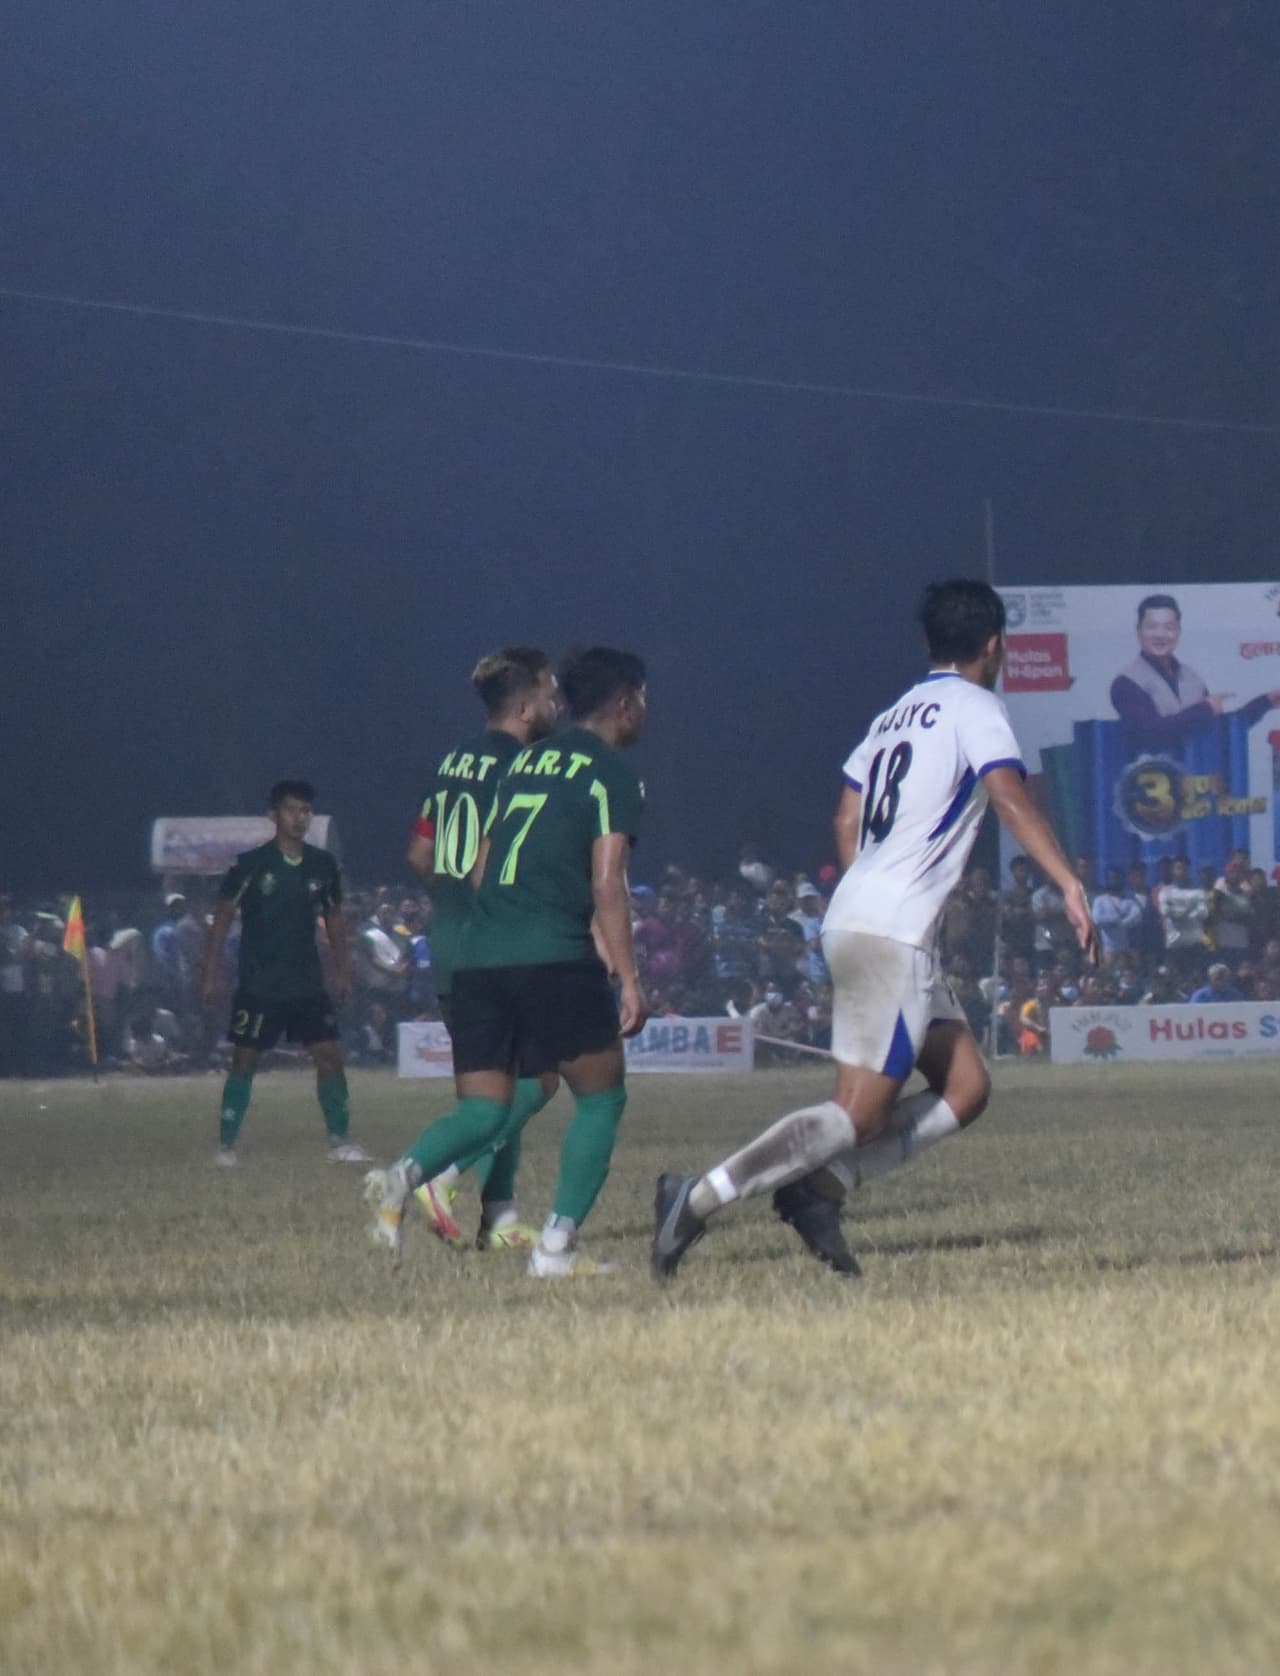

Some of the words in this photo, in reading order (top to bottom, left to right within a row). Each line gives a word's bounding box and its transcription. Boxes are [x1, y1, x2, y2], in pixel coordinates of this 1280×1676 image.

[508, 749, 593, 779] N.R.T
[860, 741, 913, 852] 18
[433, 790, 480, 880] 10
[499, 793, 549, 885] 7
[233, 1009, 264, 1039] 21
[1150, 1018, 1248, 1042] Hulas
